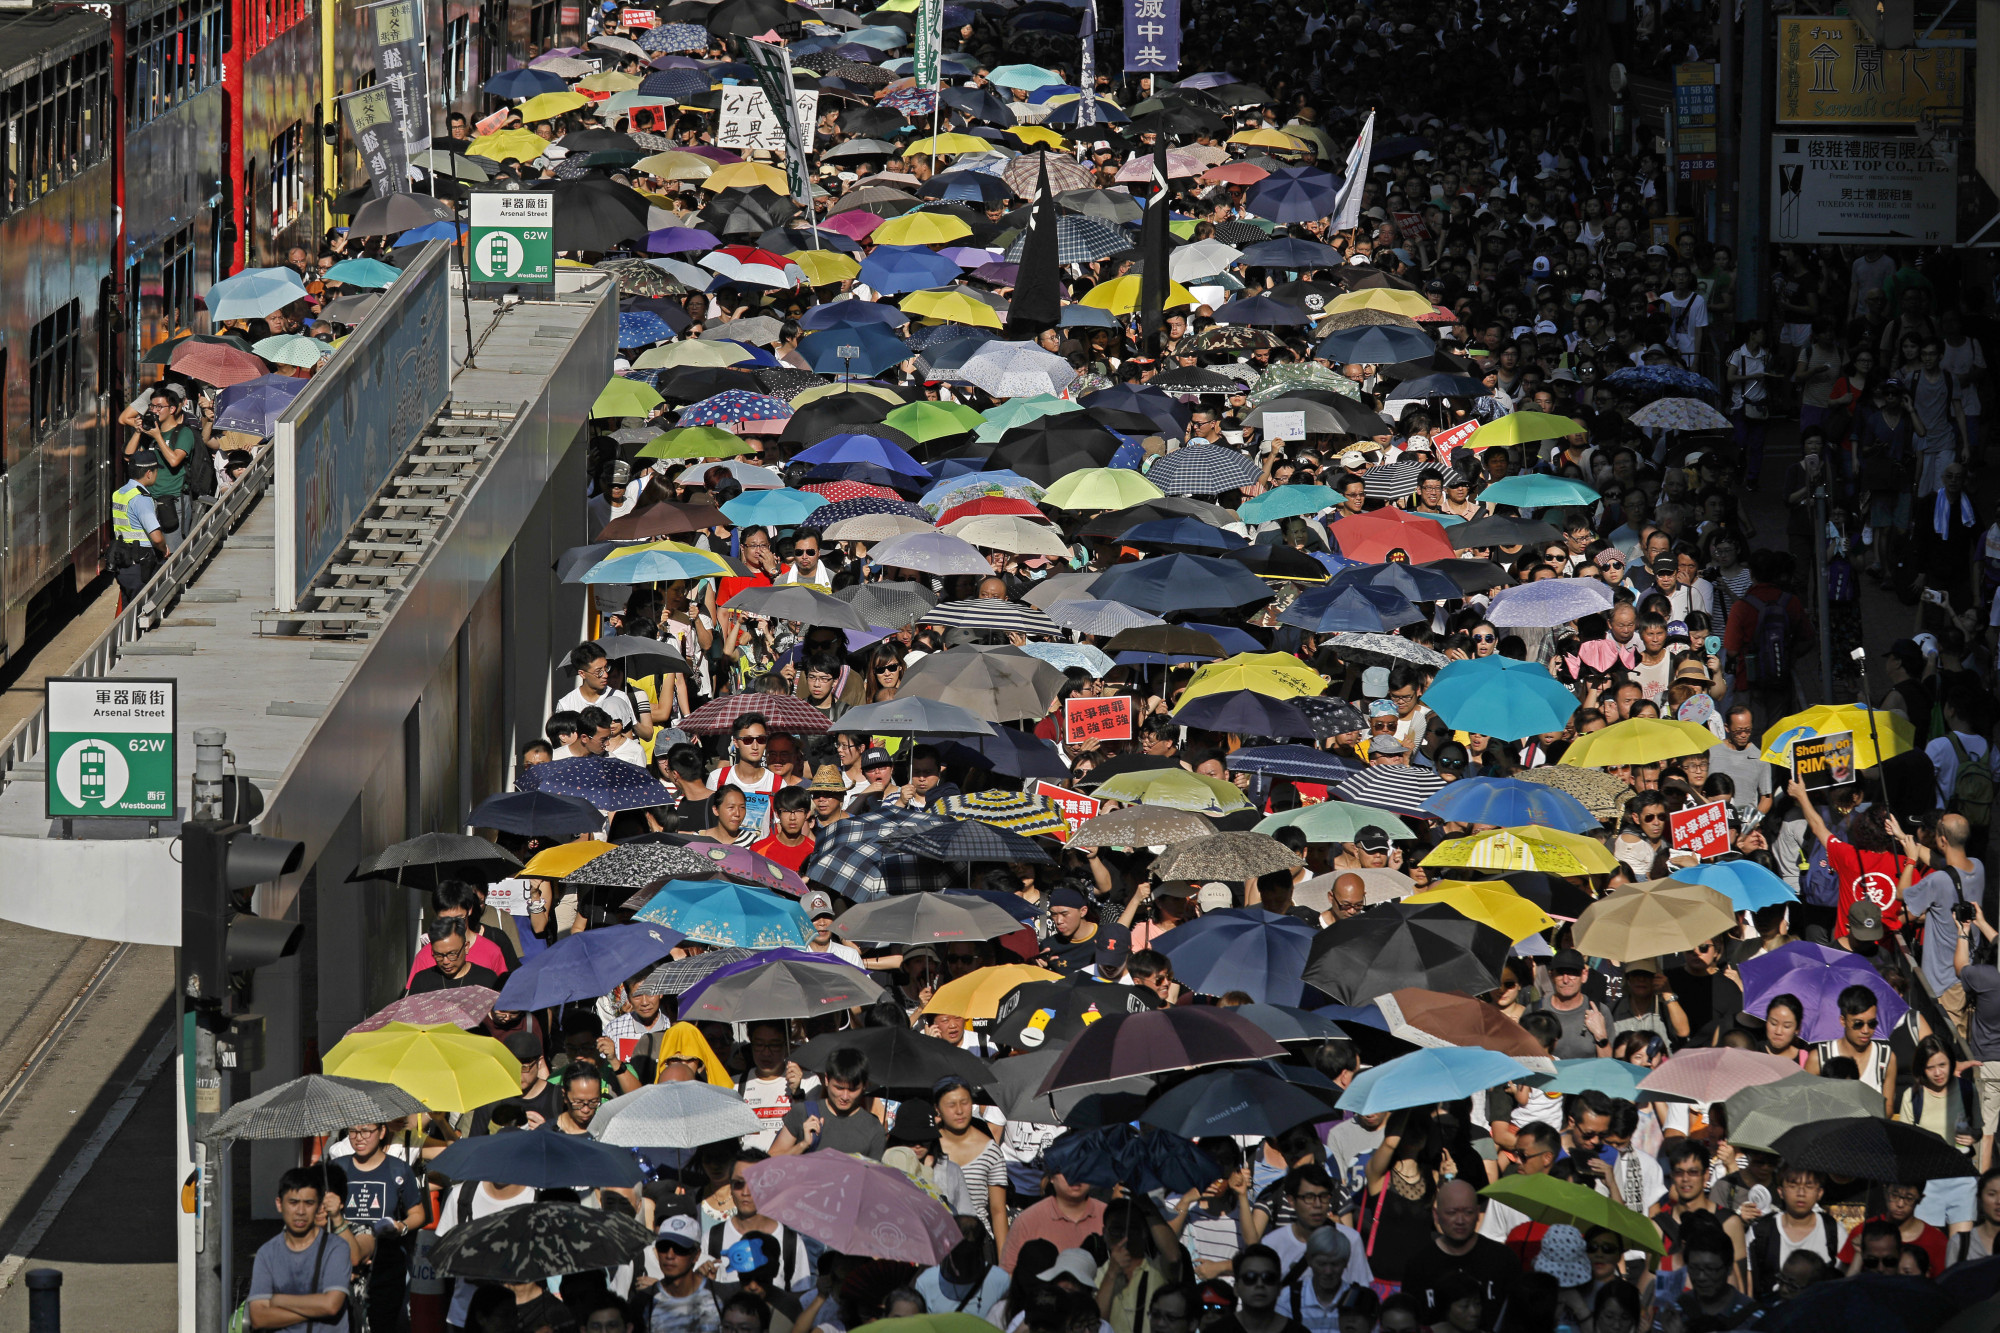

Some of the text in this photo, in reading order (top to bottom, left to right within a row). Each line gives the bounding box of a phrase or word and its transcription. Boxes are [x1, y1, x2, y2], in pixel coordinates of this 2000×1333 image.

[1134, 0, 1167, 67] 滅中共
[917, 15, 927, 69] Professional
[918, 70, 927, 85] HK
[724, 91, 817, 121] 公民命
[1808, 140, 1935, 160] 俊雅禮服有限公
[1680, 161, 1690, 170] 23
[1705, 160, 1715, 168] 25
[1810, 159, 1849, 171] TUXE
[1852, 160, 1883, 171] TOP
[1680, 170, 1690, 179] 26
[1840, 188, 1912, 201] 男士禮服租售
[502, 198, 548, 209] 軍器廠街
[1817, 200, 1855, 208] TUXEDOS
[1840, 211, 1910, 220] www.tuxetop.com
[523, 231, 548, 240] 62W
[535, 265, 548, 273] 西行
[96, 689, 165, 706] 軍器廠街
[93, 709, 165, 718] Arsenal Street
[1070, 699, 1126, 724] 抗爭無罪
[128, 739, 166, 752] 62W
[1796, 738, 1850, 757] Shame on
[147, 791, 166, 801] 西行
[119, 802, 166, 810] Westbound
[1674, 805, 1722, 842] 抗爭無罪
[1206, 1100, 1249, 1124] mont-bell
